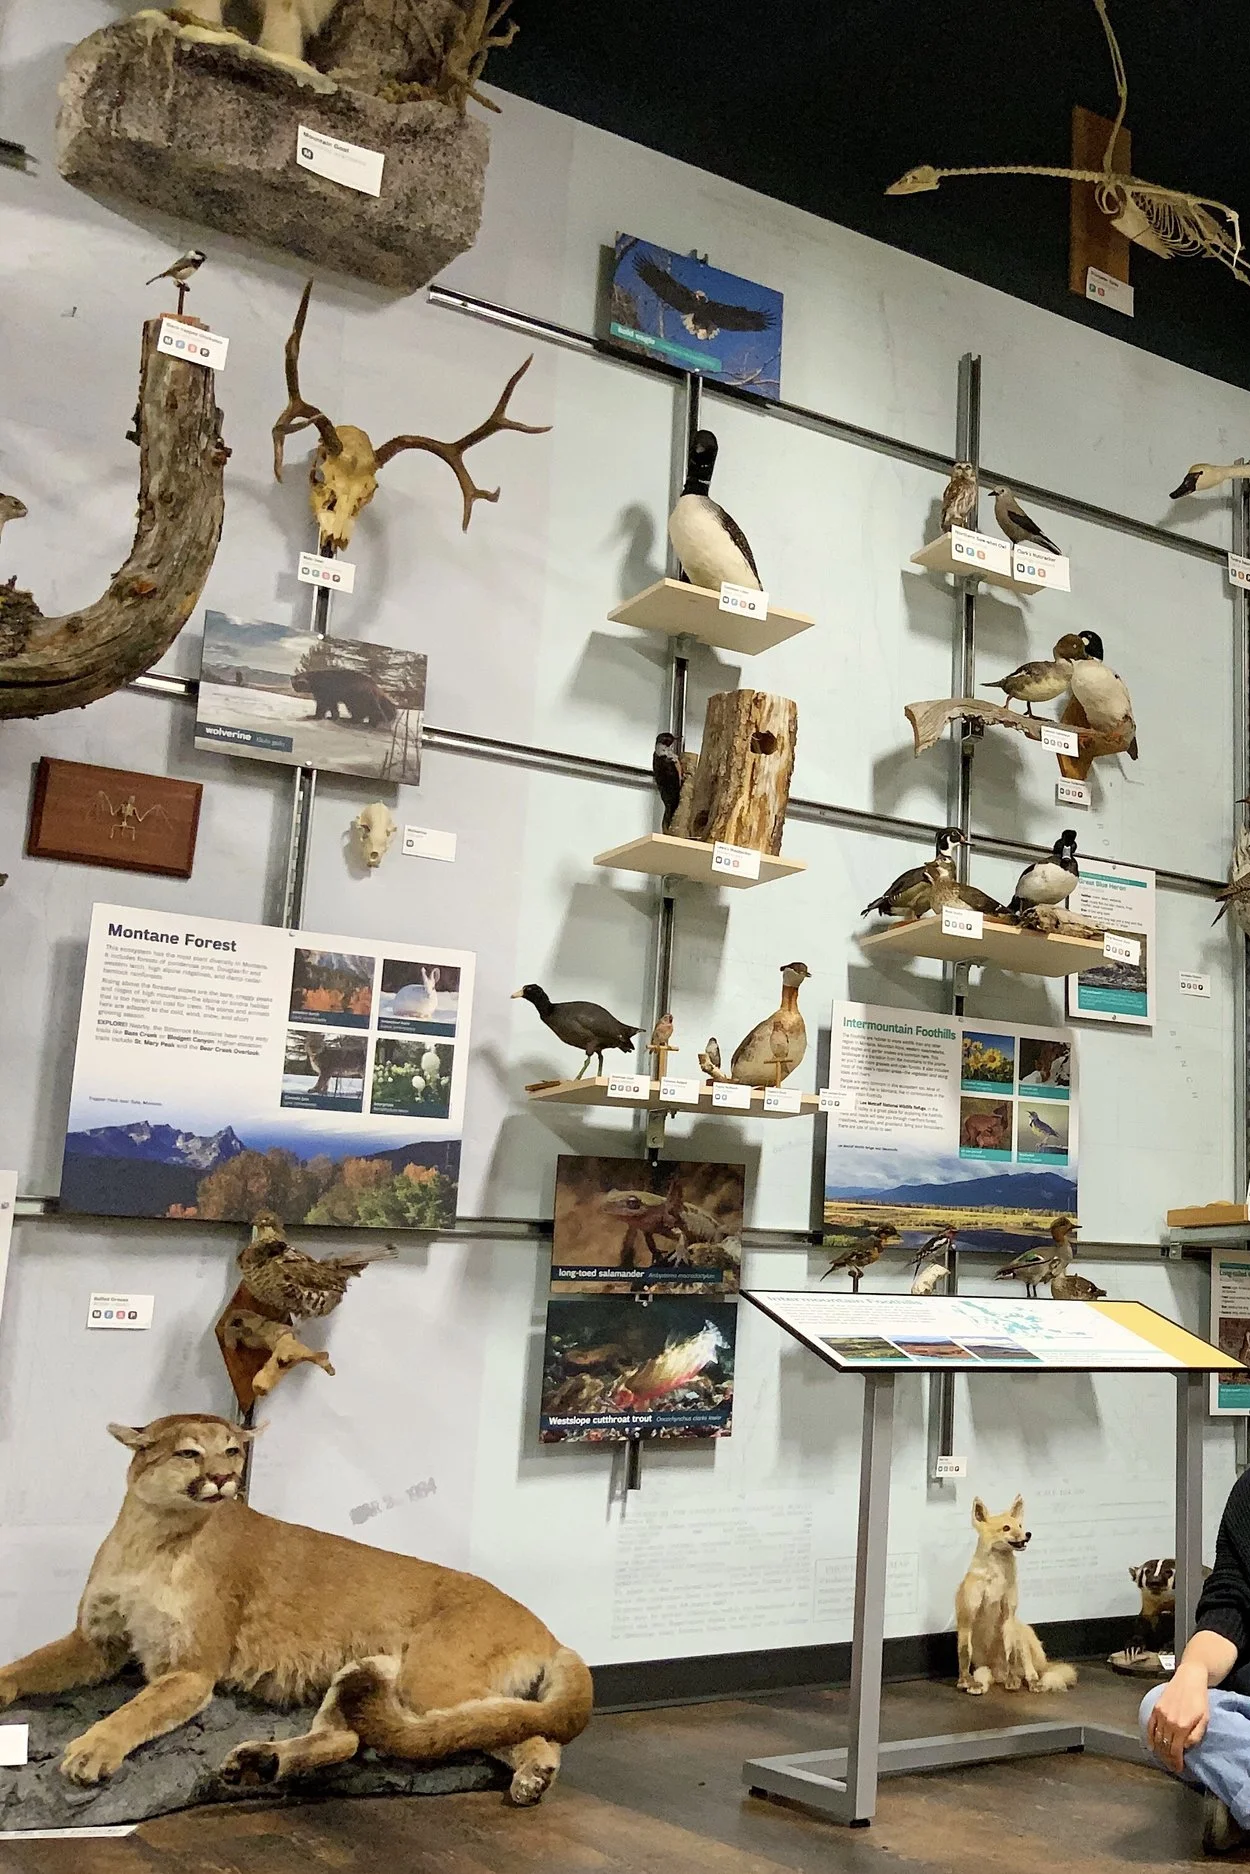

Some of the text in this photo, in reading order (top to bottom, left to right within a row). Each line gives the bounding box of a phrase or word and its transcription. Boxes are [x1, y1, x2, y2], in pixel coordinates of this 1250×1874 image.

[206, 728, 252, 740] wolverine
[108, 923, 237, 952] Montane Forest
[844, 1017, 956, 1040] Intermountain Foothills
[559, 1268, 597, 1278] long-toed
[598, 1270, 645, 1278] salamander
[549, 1416, 590, 1426] Westslope
[593, 1415, 630, 1424] cutthroat
[632, 1415, 652, 1423] trout
